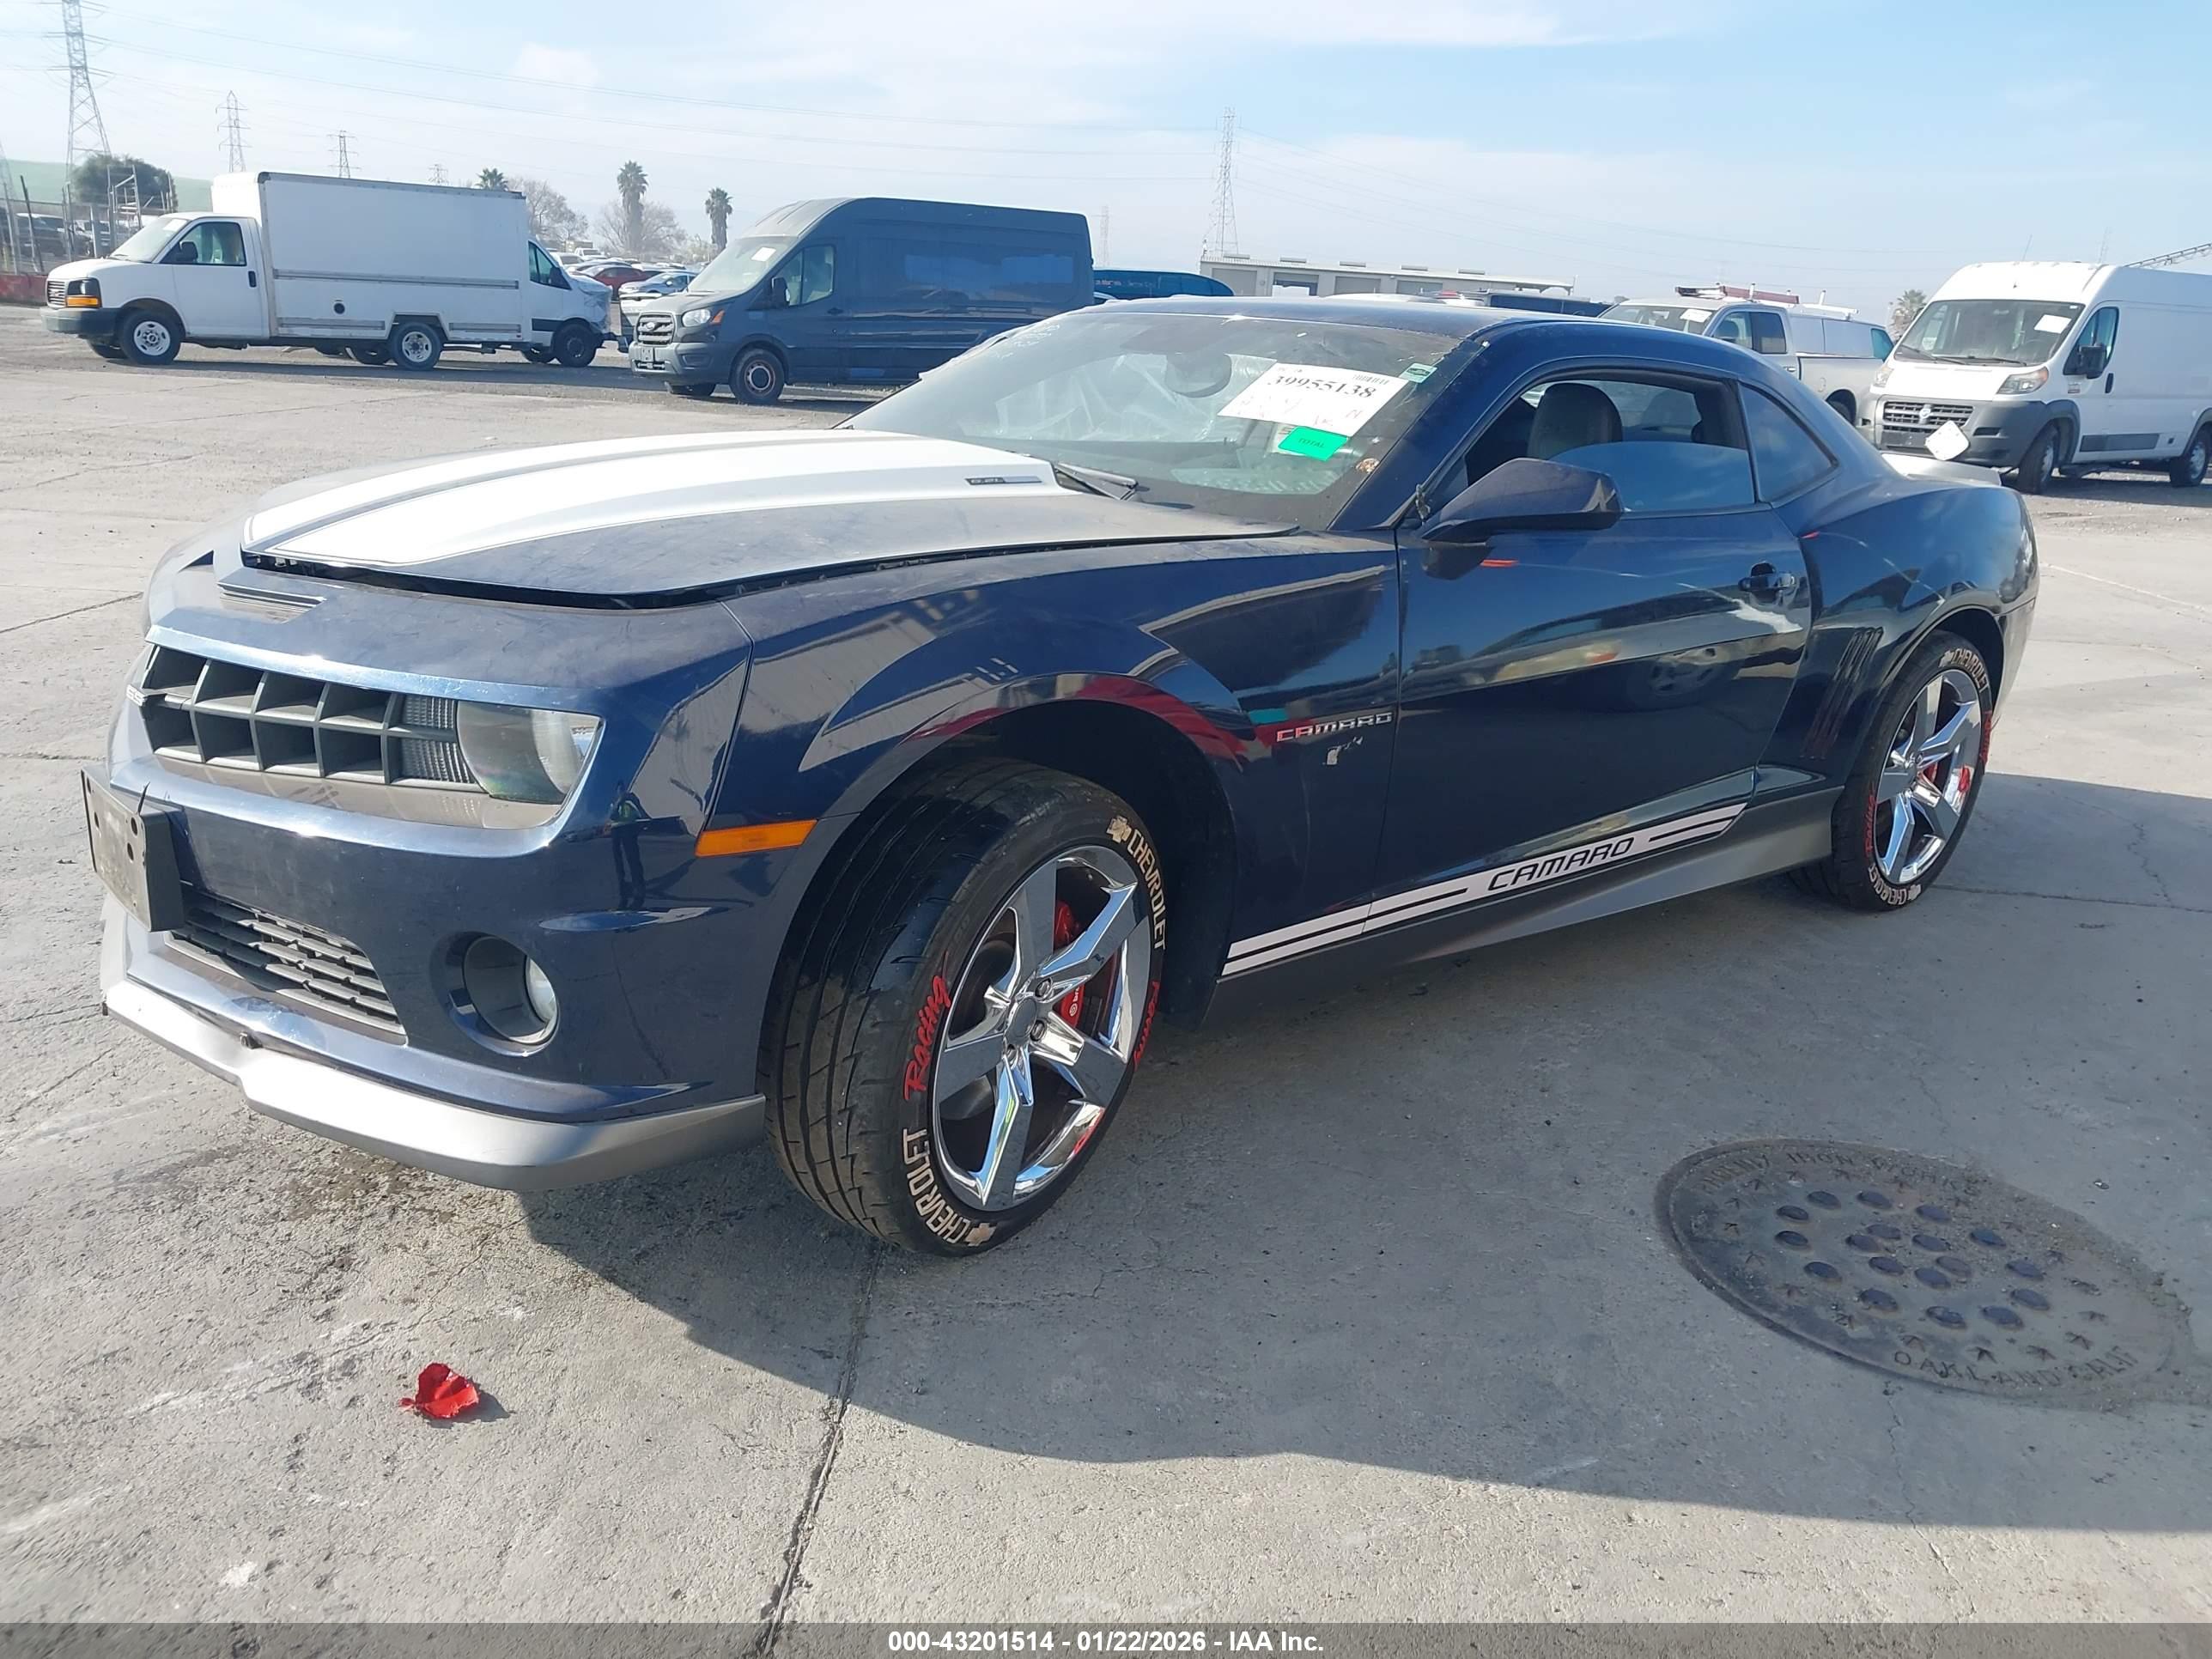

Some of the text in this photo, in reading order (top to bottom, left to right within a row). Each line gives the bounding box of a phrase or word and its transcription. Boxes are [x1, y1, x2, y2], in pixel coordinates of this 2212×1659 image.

[1267, 375, 1377, 398] 39955138
[1297, 437, 1326, 449] TOTAL
[1276, 712, 1393, 743] CAMARO
[1127, 829, 1166, 951] CHEVROLET
[1487, 836, 1635, 891] CAMARO
[903, 950, 951, 1101] Racing
[902, 1128, 971, 1244] CHEVROLET
